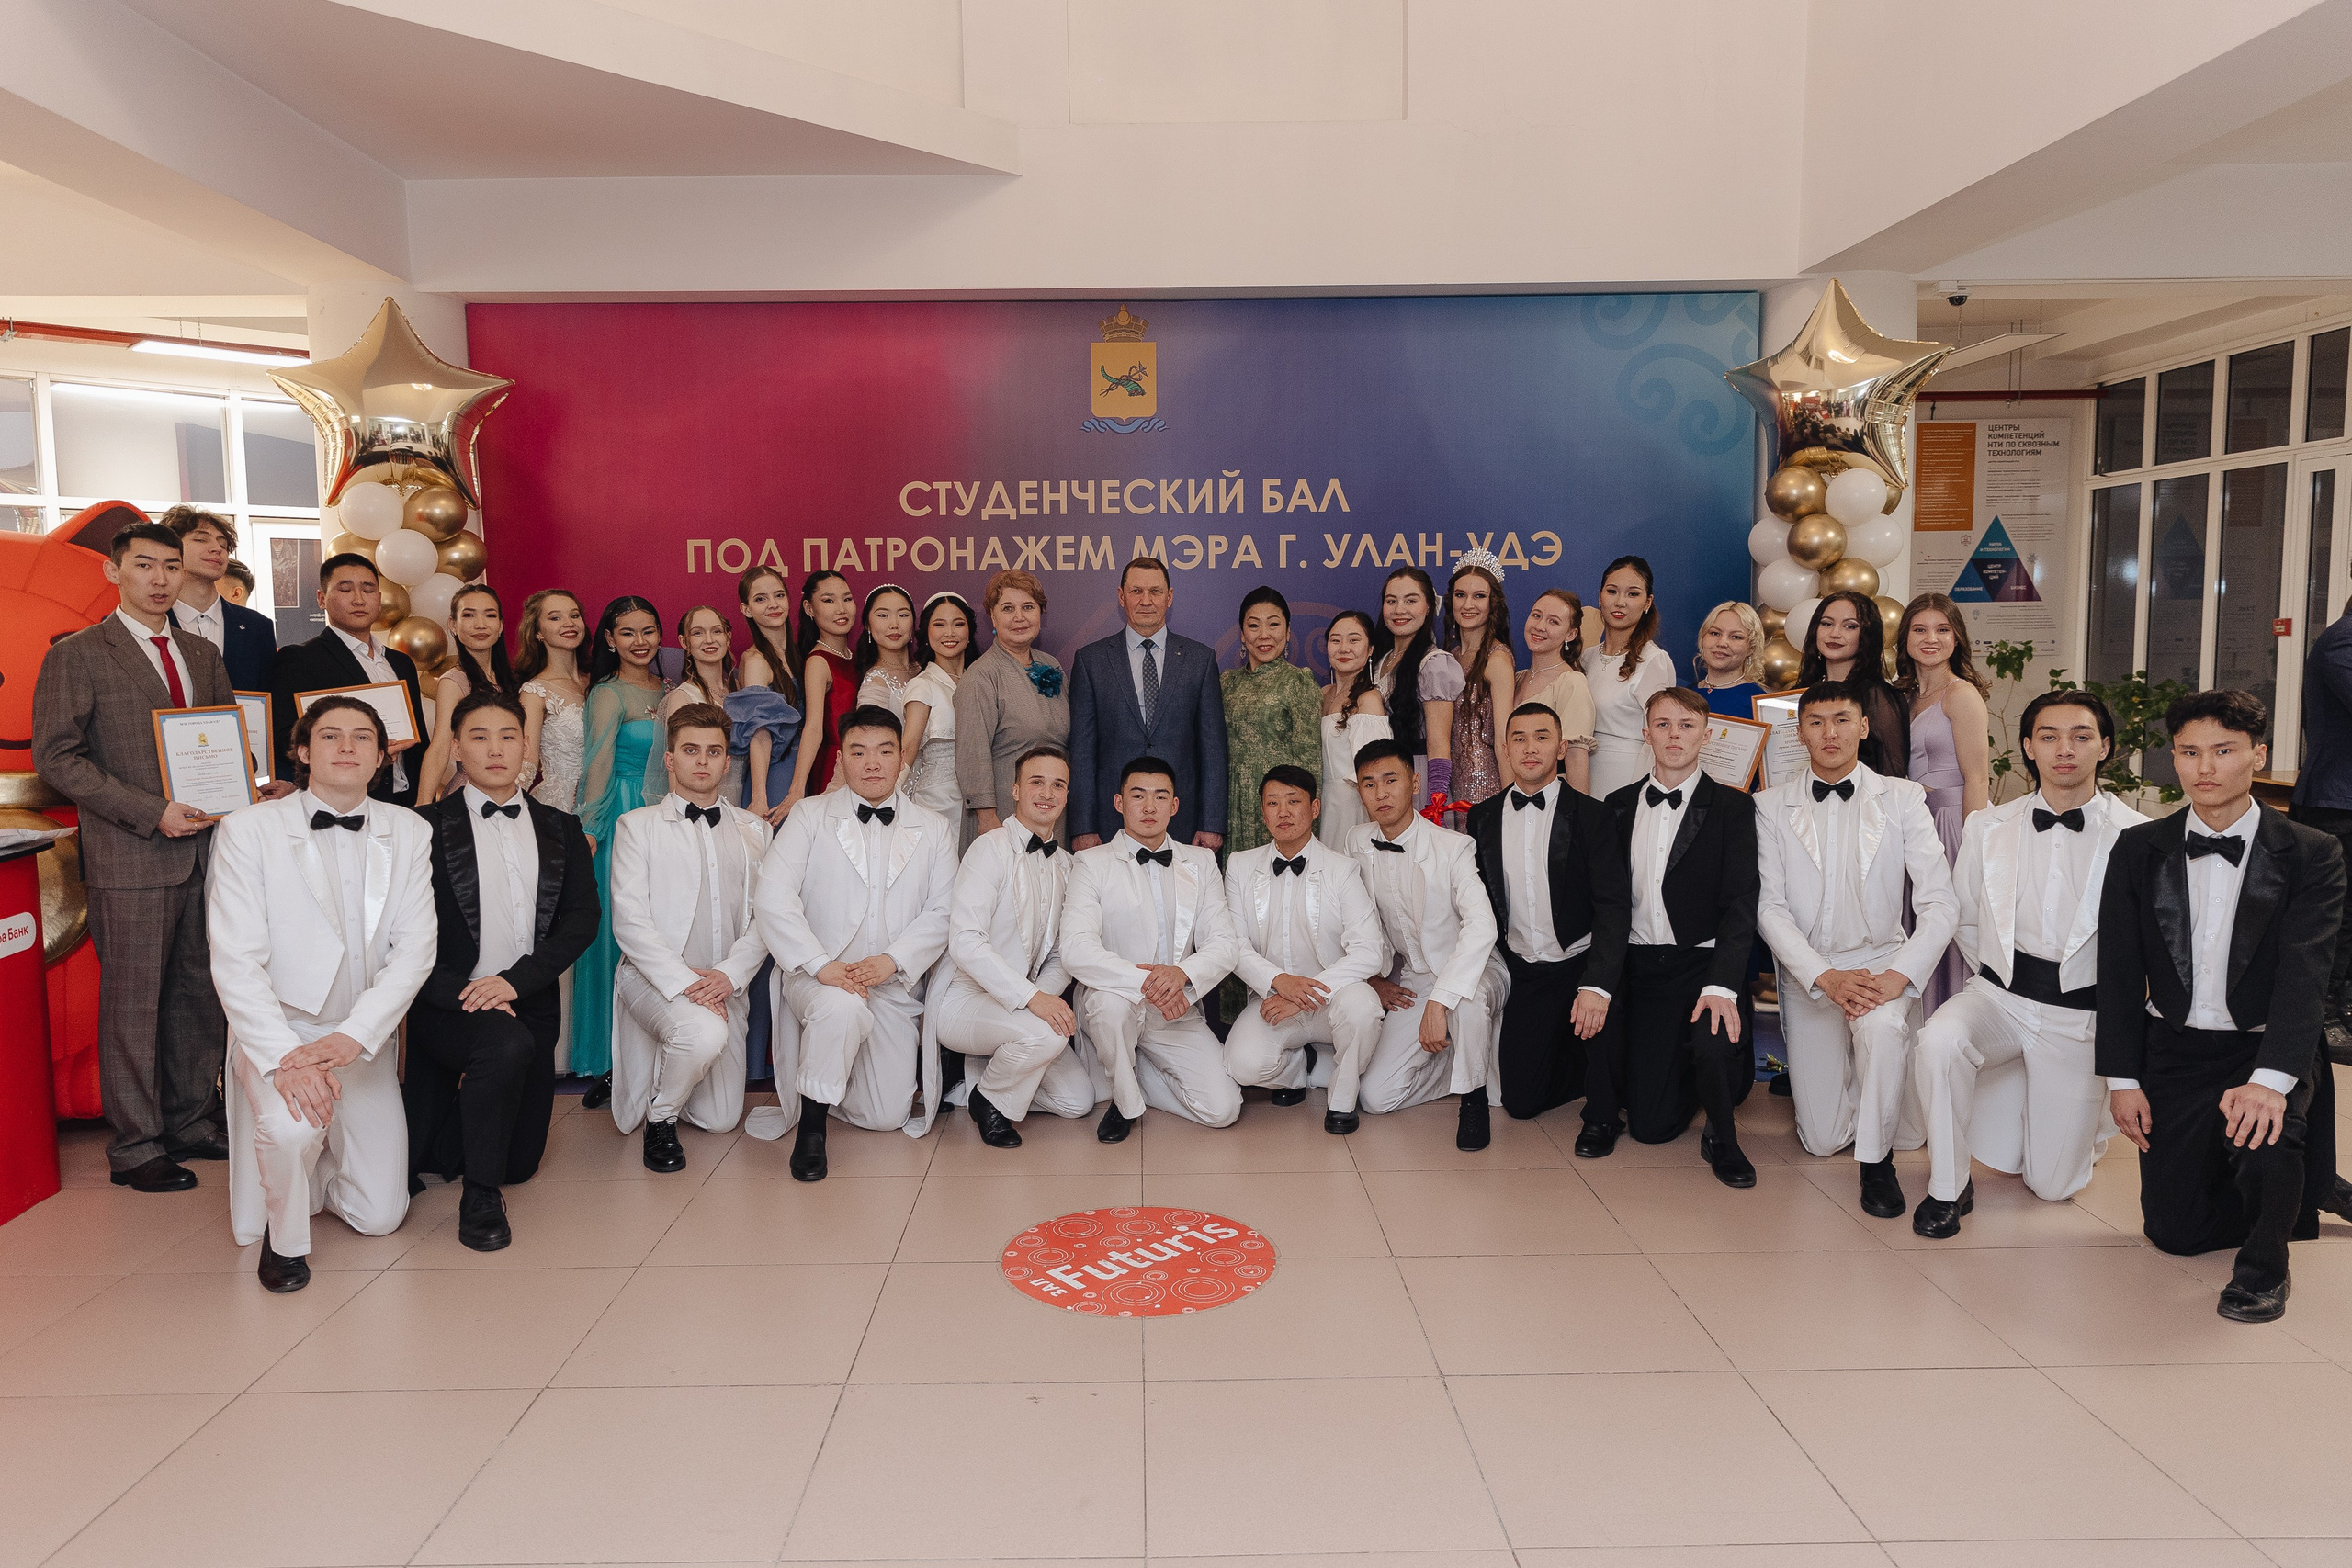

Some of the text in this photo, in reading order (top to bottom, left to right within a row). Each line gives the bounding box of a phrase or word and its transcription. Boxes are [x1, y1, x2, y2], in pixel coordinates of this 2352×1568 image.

[1987, 424, 2020, 433] ЦЕНТРЫ
[1987, 430, 2045, 440] КОМПЕТЕНЦИЙ
[899, 470, 1351, 520] СТУДЕНЧЕСКИЙ БАЛ
[686, 538, 788, 577] ПОД
[803, 536, 1116, 573] ПАТРОНАЖЕМ
[1130, 533, 1264, 571] МЭРА
[1279, 533, 1308, 569] Г.
[175, 748, 233, 757] БЛАГОДАРСТВЕННОЕ
[7, 926, 29, 940] Банк
[1046, 1223, 1238, 1289] Futuris
[1030, 1276, 1069, 1298] ЗАЛ
